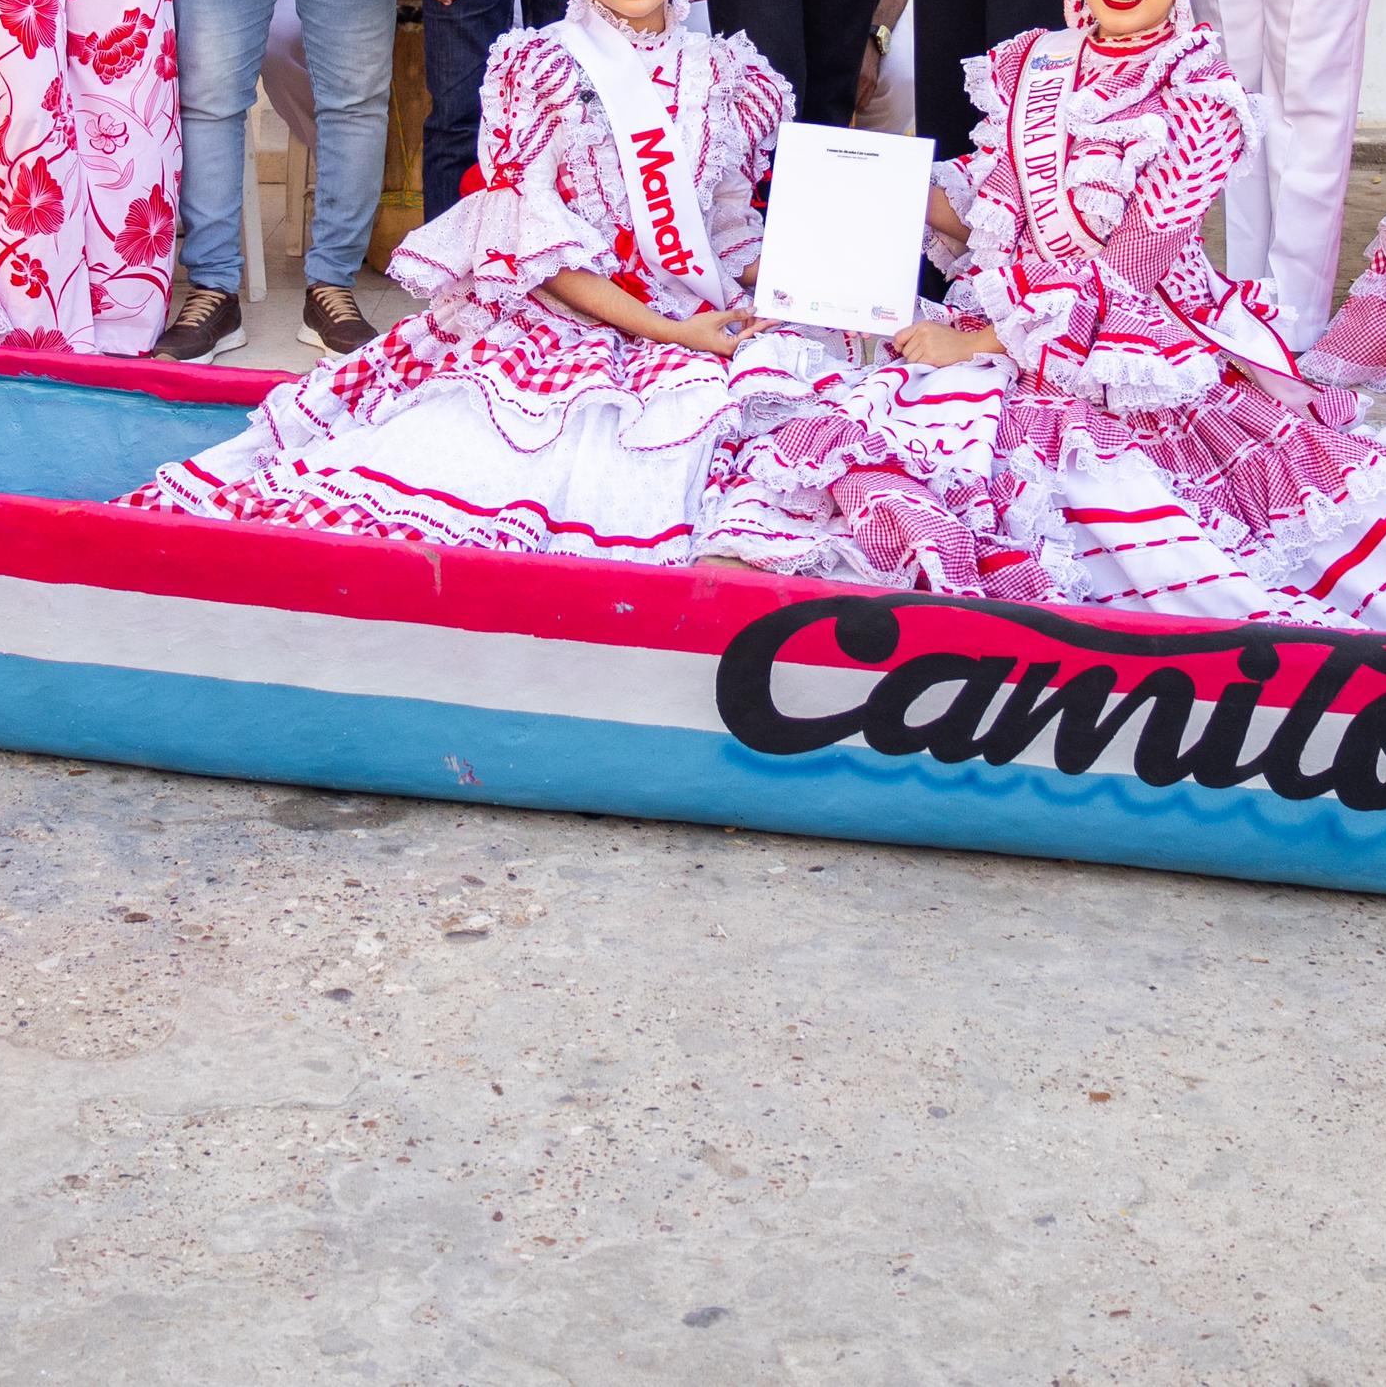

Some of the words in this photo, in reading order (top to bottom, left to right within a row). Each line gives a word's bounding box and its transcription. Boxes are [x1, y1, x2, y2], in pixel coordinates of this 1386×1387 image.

[1024, 77, 1065, 148] SIRENA
[630, 127, 704, 276] Manatí
[1024, 150, 1059, 234] DPTAL.
